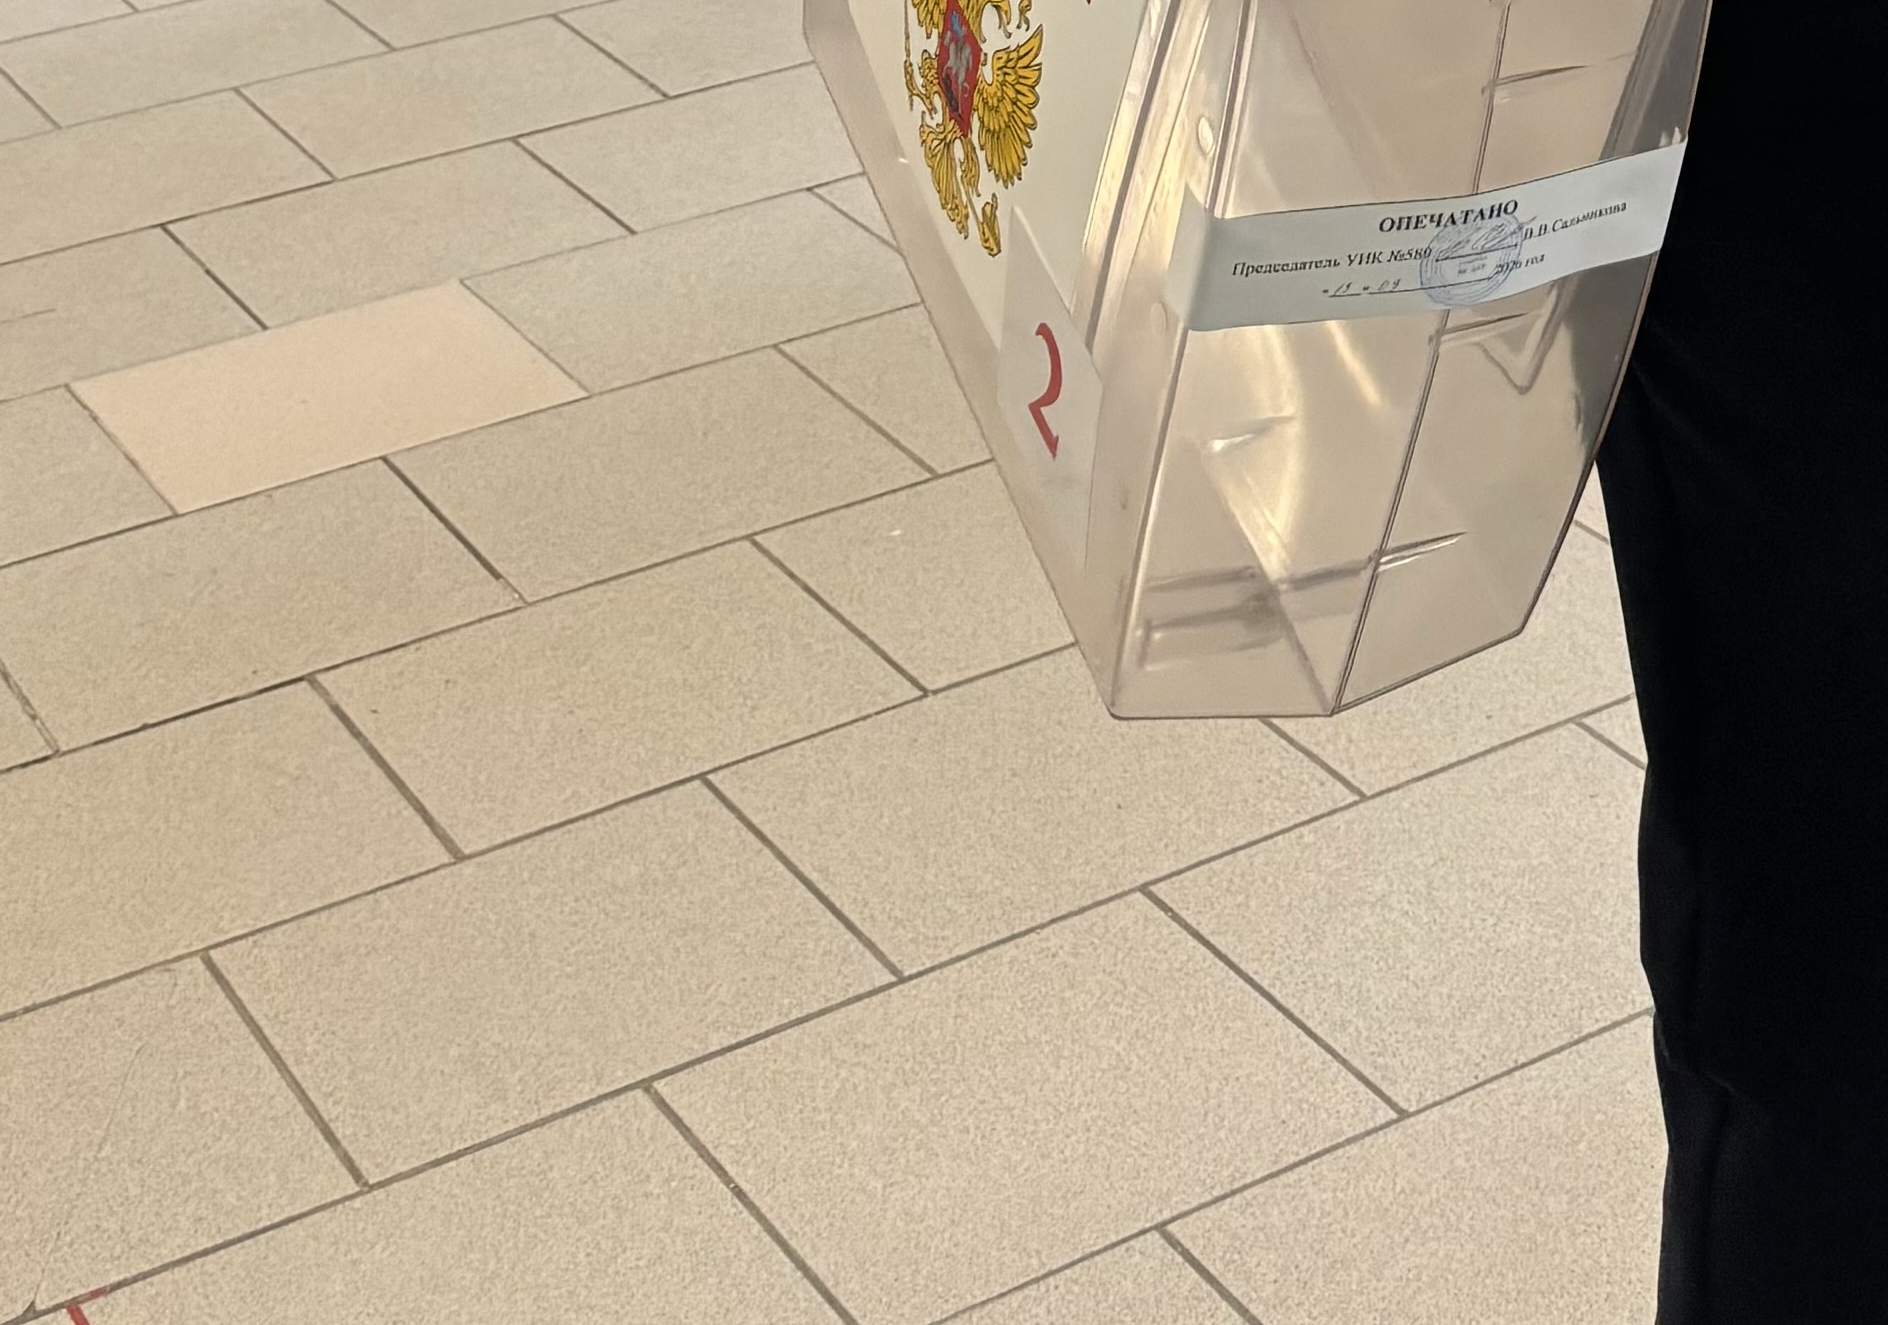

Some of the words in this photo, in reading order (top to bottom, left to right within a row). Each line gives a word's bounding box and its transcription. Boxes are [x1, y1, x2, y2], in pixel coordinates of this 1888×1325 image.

[1379, 199, 1519, 233] ОПЕЧАТАНО
[1232, 258, 1340, 278] Председатель
[1346, 250, 1383, 267] УИК
[1028, 321, 1064, 460] 2
